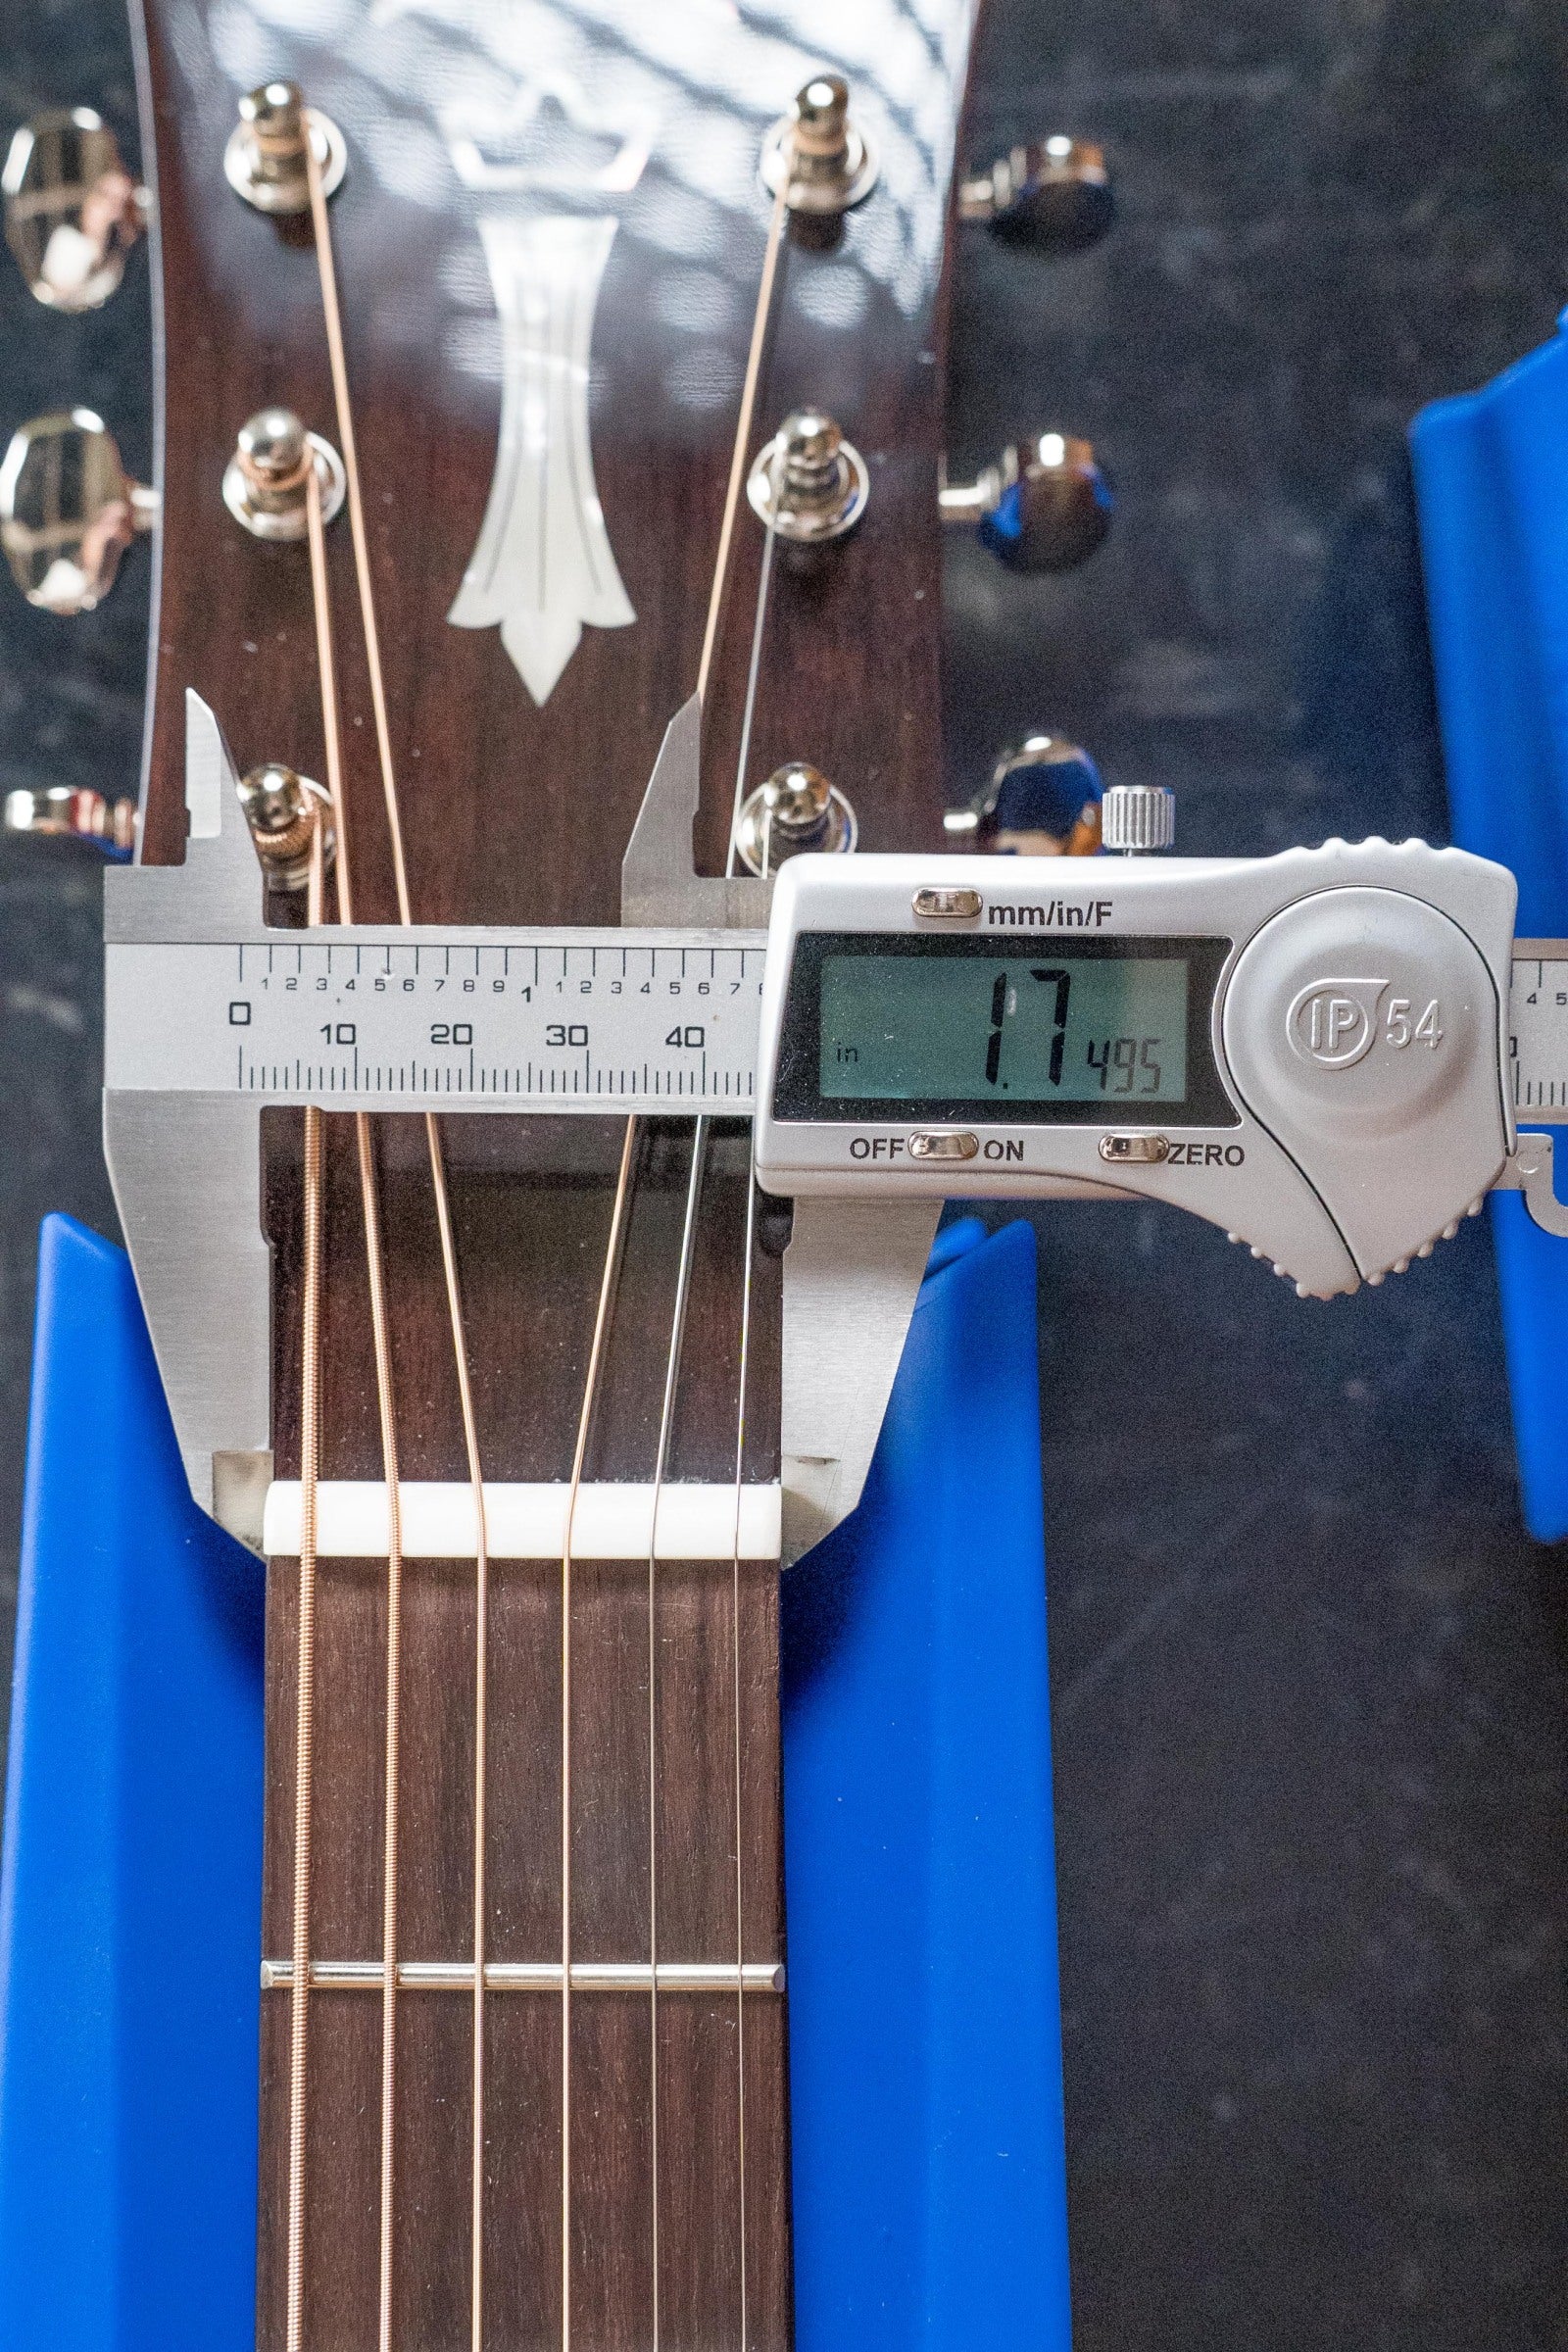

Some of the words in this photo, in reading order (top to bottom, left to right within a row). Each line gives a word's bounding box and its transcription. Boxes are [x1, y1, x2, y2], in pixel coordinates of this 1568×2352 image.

[988, 901, 1113, 927] mm/in/F
[261, 978, 269, 991] 1
[284, 977, 298, 991] 2
[316, 978, 328, 991] 3
[345, 978, 356, 992] 4
[374, 979, 386, 992] 5
[403, 979, 415, 992] 6
[433, 979, 446, 992] 7
[463, 979, 475, 992] 8
[492, 980, 506, 993] 9
[520, 986, 532, 1004] 1
[555, 981, 563, 994] 1
[579, 981, 593, 994] 2
[611, 981, 623, 995] 3
[640, 982, 652, 995] 4
[668, 982, 681, 996] 5
[698, 982, 710, 996] 6
[728, 983, 741, 996] 7
[1526, 993, 1537, 1004] 4
[1556, 993, 1567, 1004] 5
[319, 1023, 357, 1046] 10
[430, 1023, 473, 1046] 20
[545, 1024, 589, 1047] 30
[664, 1025, 706, 1049] 40
[1310, 999, 1359, 1049] IP
[1386, 1000, 1443, 1049] 54
[836, 1042, 858, 1063] in
[850, 1138, 905, 1159] OFF
[983, 1140, 1025, 1161] ON
[1168, 1144, 1245, 1166] ZERO
